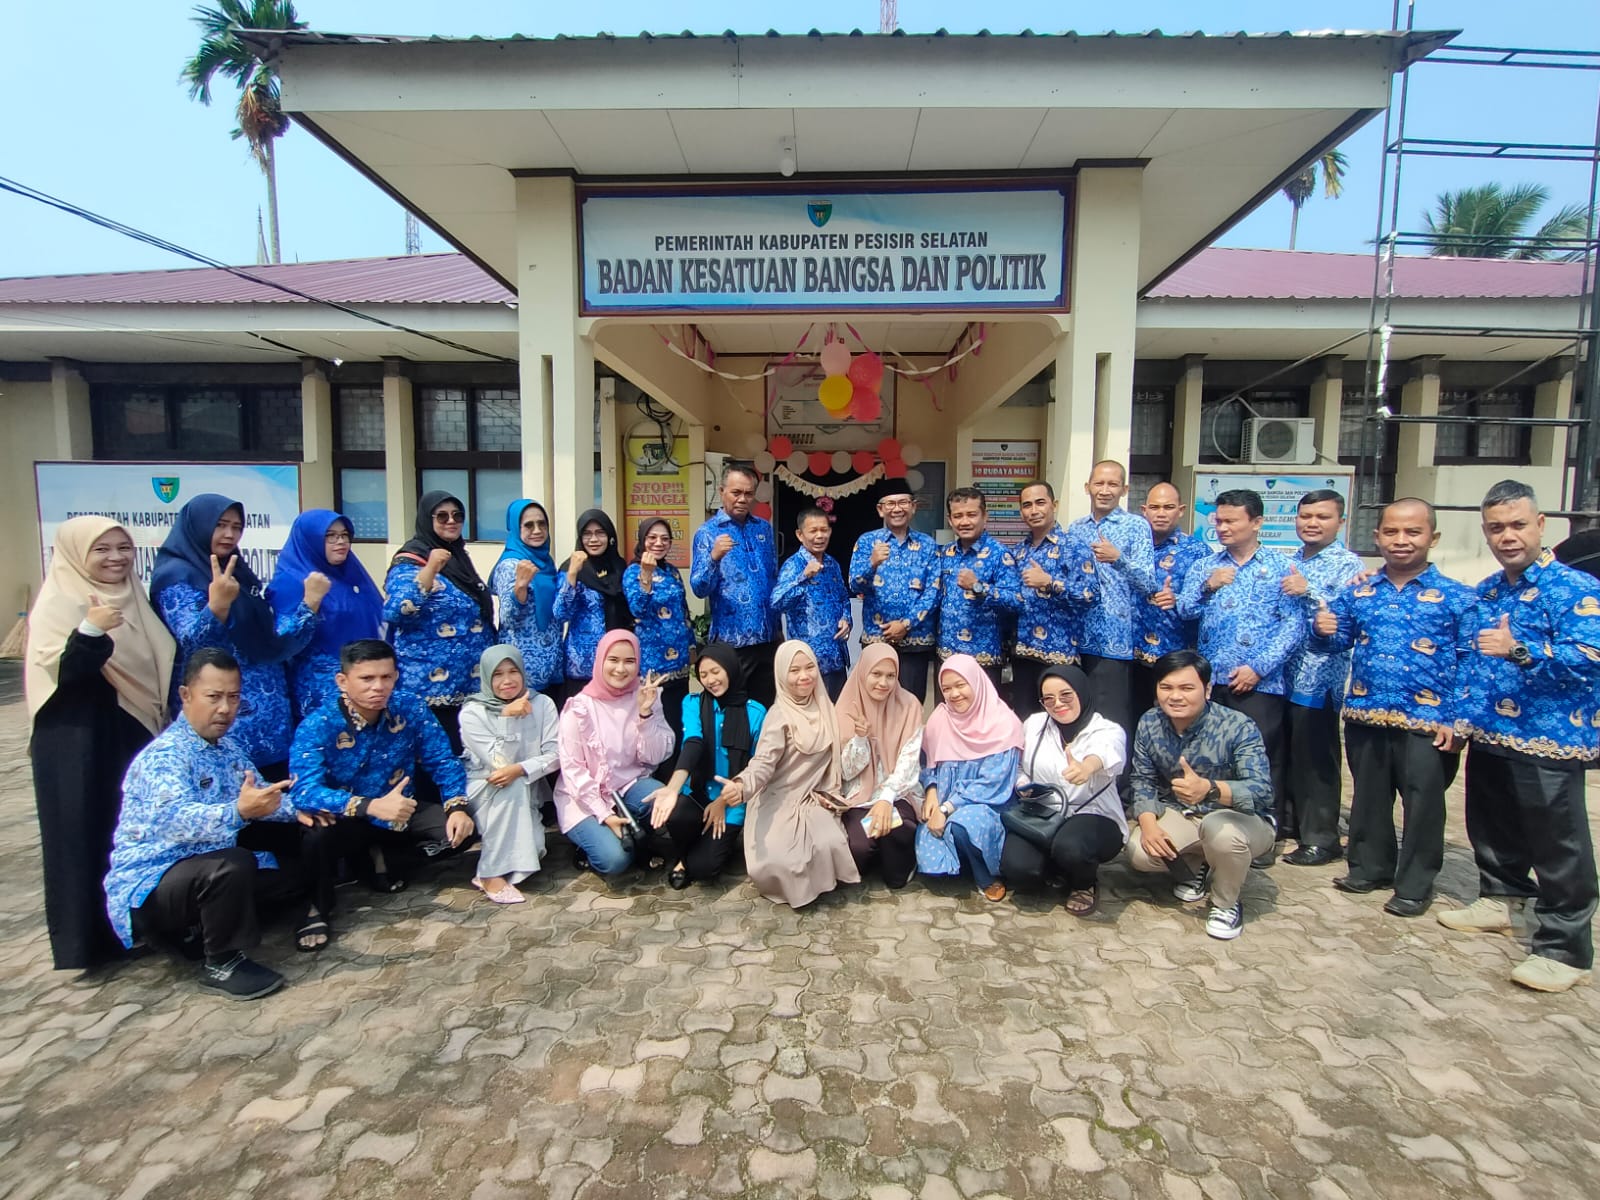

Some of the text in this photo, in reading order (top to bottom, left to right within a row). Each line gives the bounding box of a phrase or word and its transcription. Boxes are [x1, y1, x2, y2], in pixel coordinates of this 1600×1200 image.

[655, 231, 988, 251] PEMERINTAH KABUPATEN PESISIR SELATAN
[597, 254, 1047, 294] BADAN KESATUAN BANGSA DAN POLITIK
[983, 466, 1012, 475] BUDAYA
[632, 482, 684, 493] STOP!!!
[630, 494, 688, 505] PUNGLI
